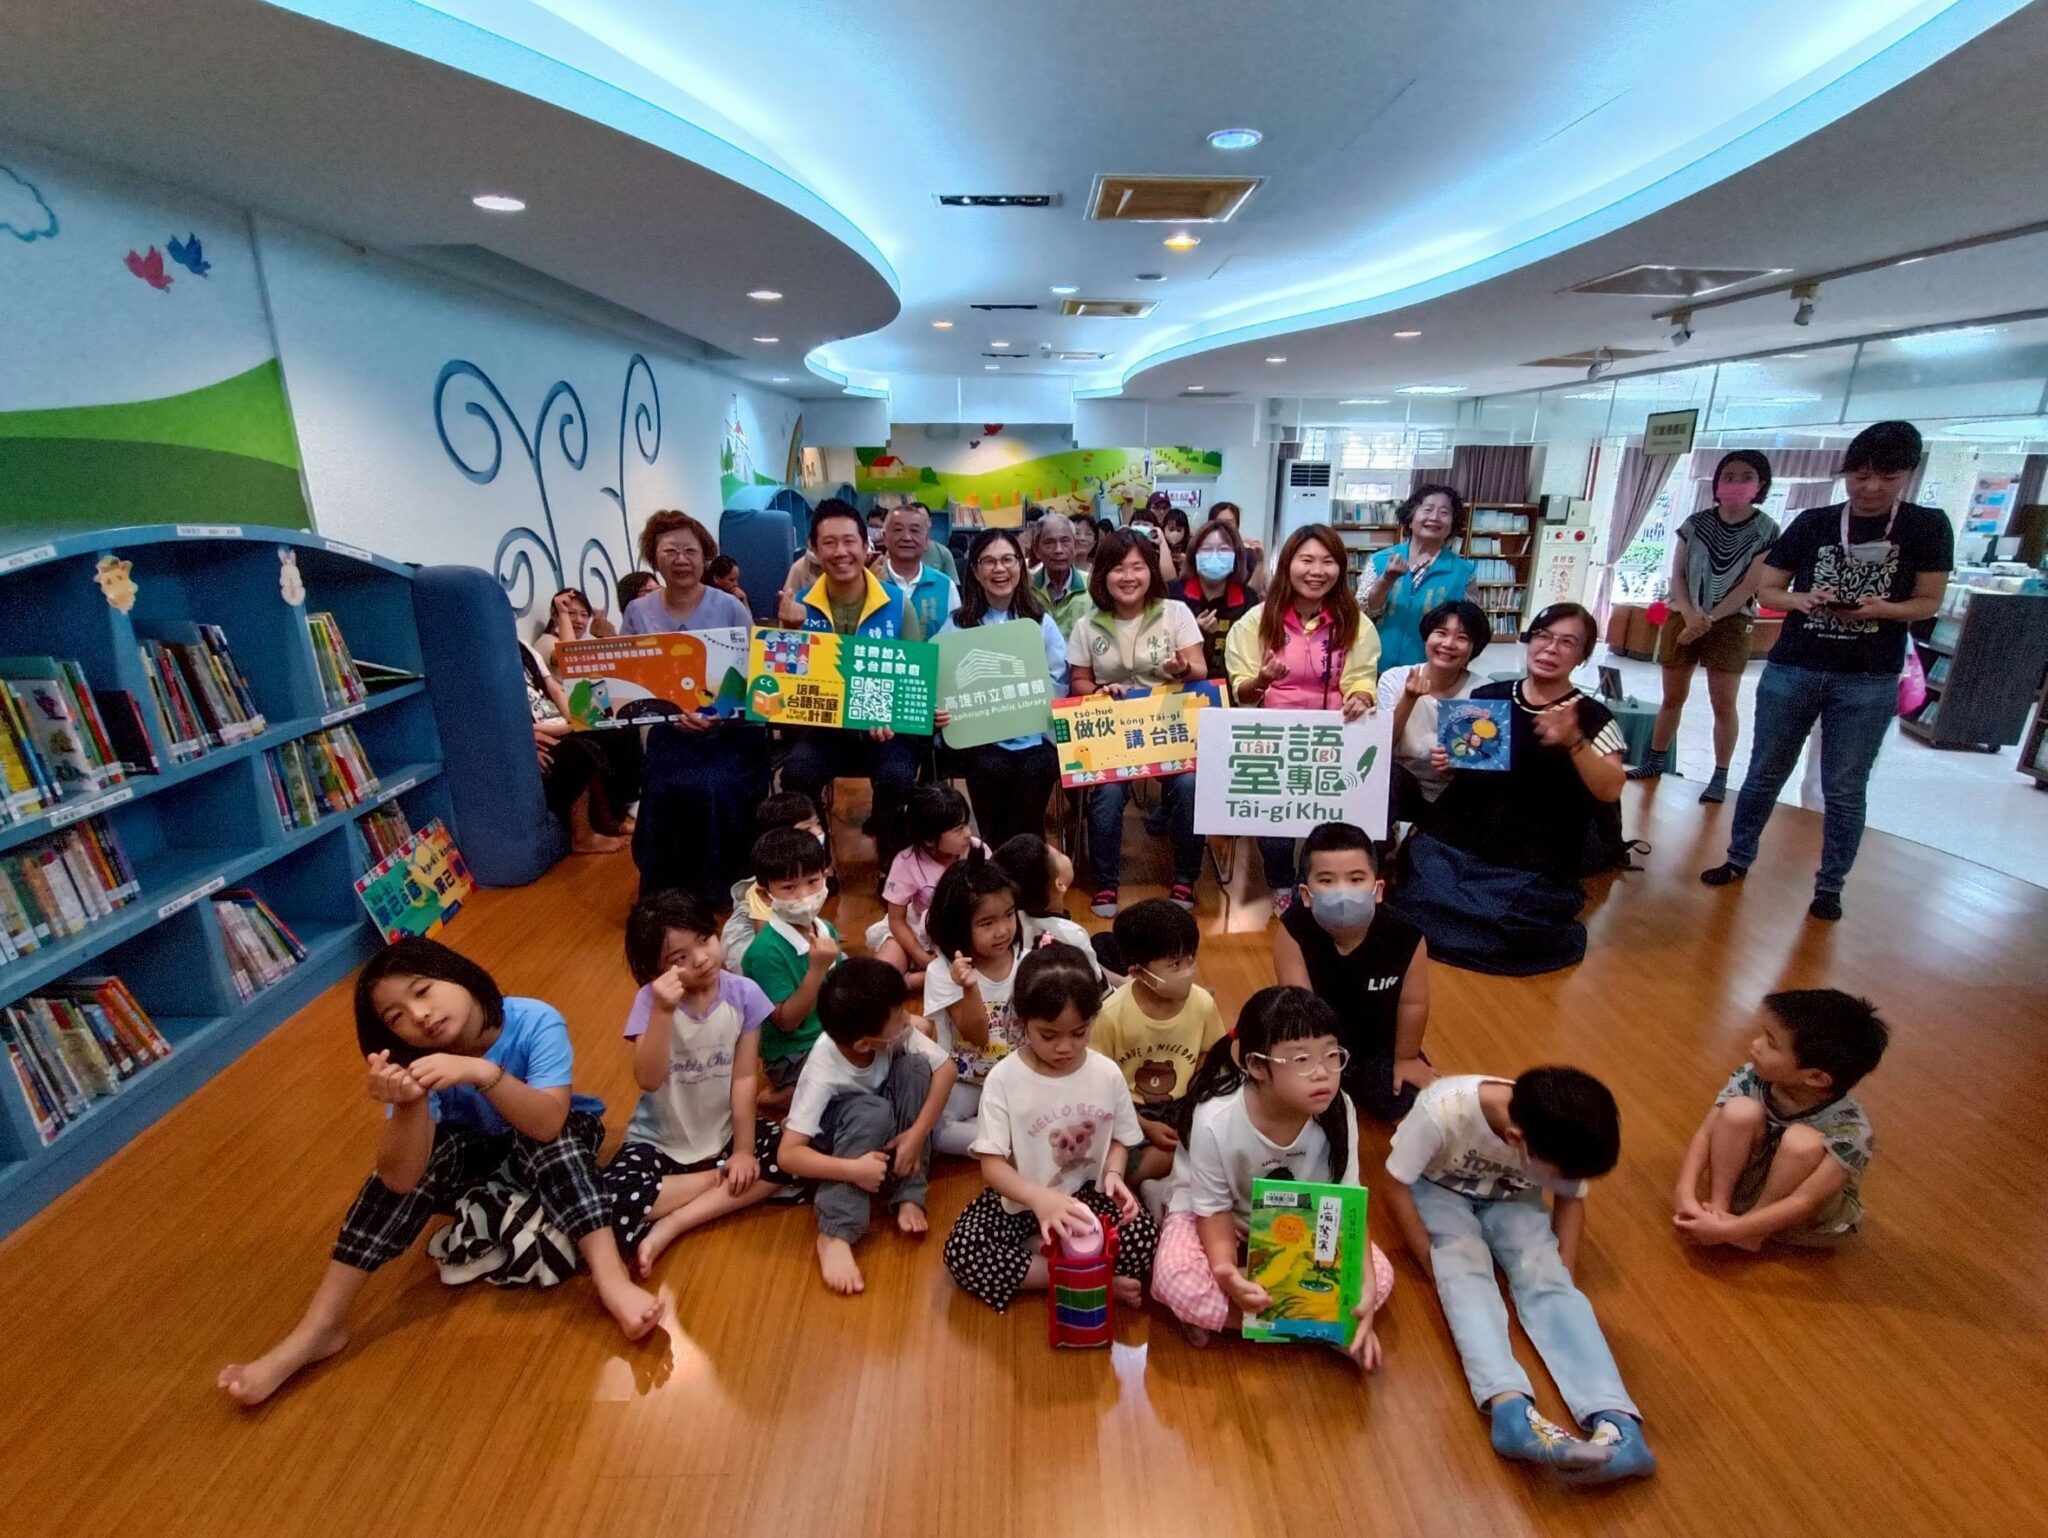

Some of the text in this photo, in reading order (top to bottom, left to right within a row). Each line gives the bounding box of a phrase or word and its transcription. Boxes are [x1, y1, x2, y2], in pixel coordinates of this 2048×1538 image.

[787, 695, 839, 712] 台語家庭
[944, 679, 1046, 710] 高雄市立圖書館
[992, 704, 1017, 714] Public
[1017, 697, 1047, 710] Library
[1074, 717, 1116, 740] 做伙
[1124, 723, 1189, 750] 講 台語
[1244, 741, 1271, 754] Tâi
[1319, 747, 1336, 763] gí
[1286, 765, 1345, 796] 專區
[1225, 800, 1343, 823] Tâi-gí Khu
[1119, 1043, 1197, 1065] HAVE A NICE DAY
